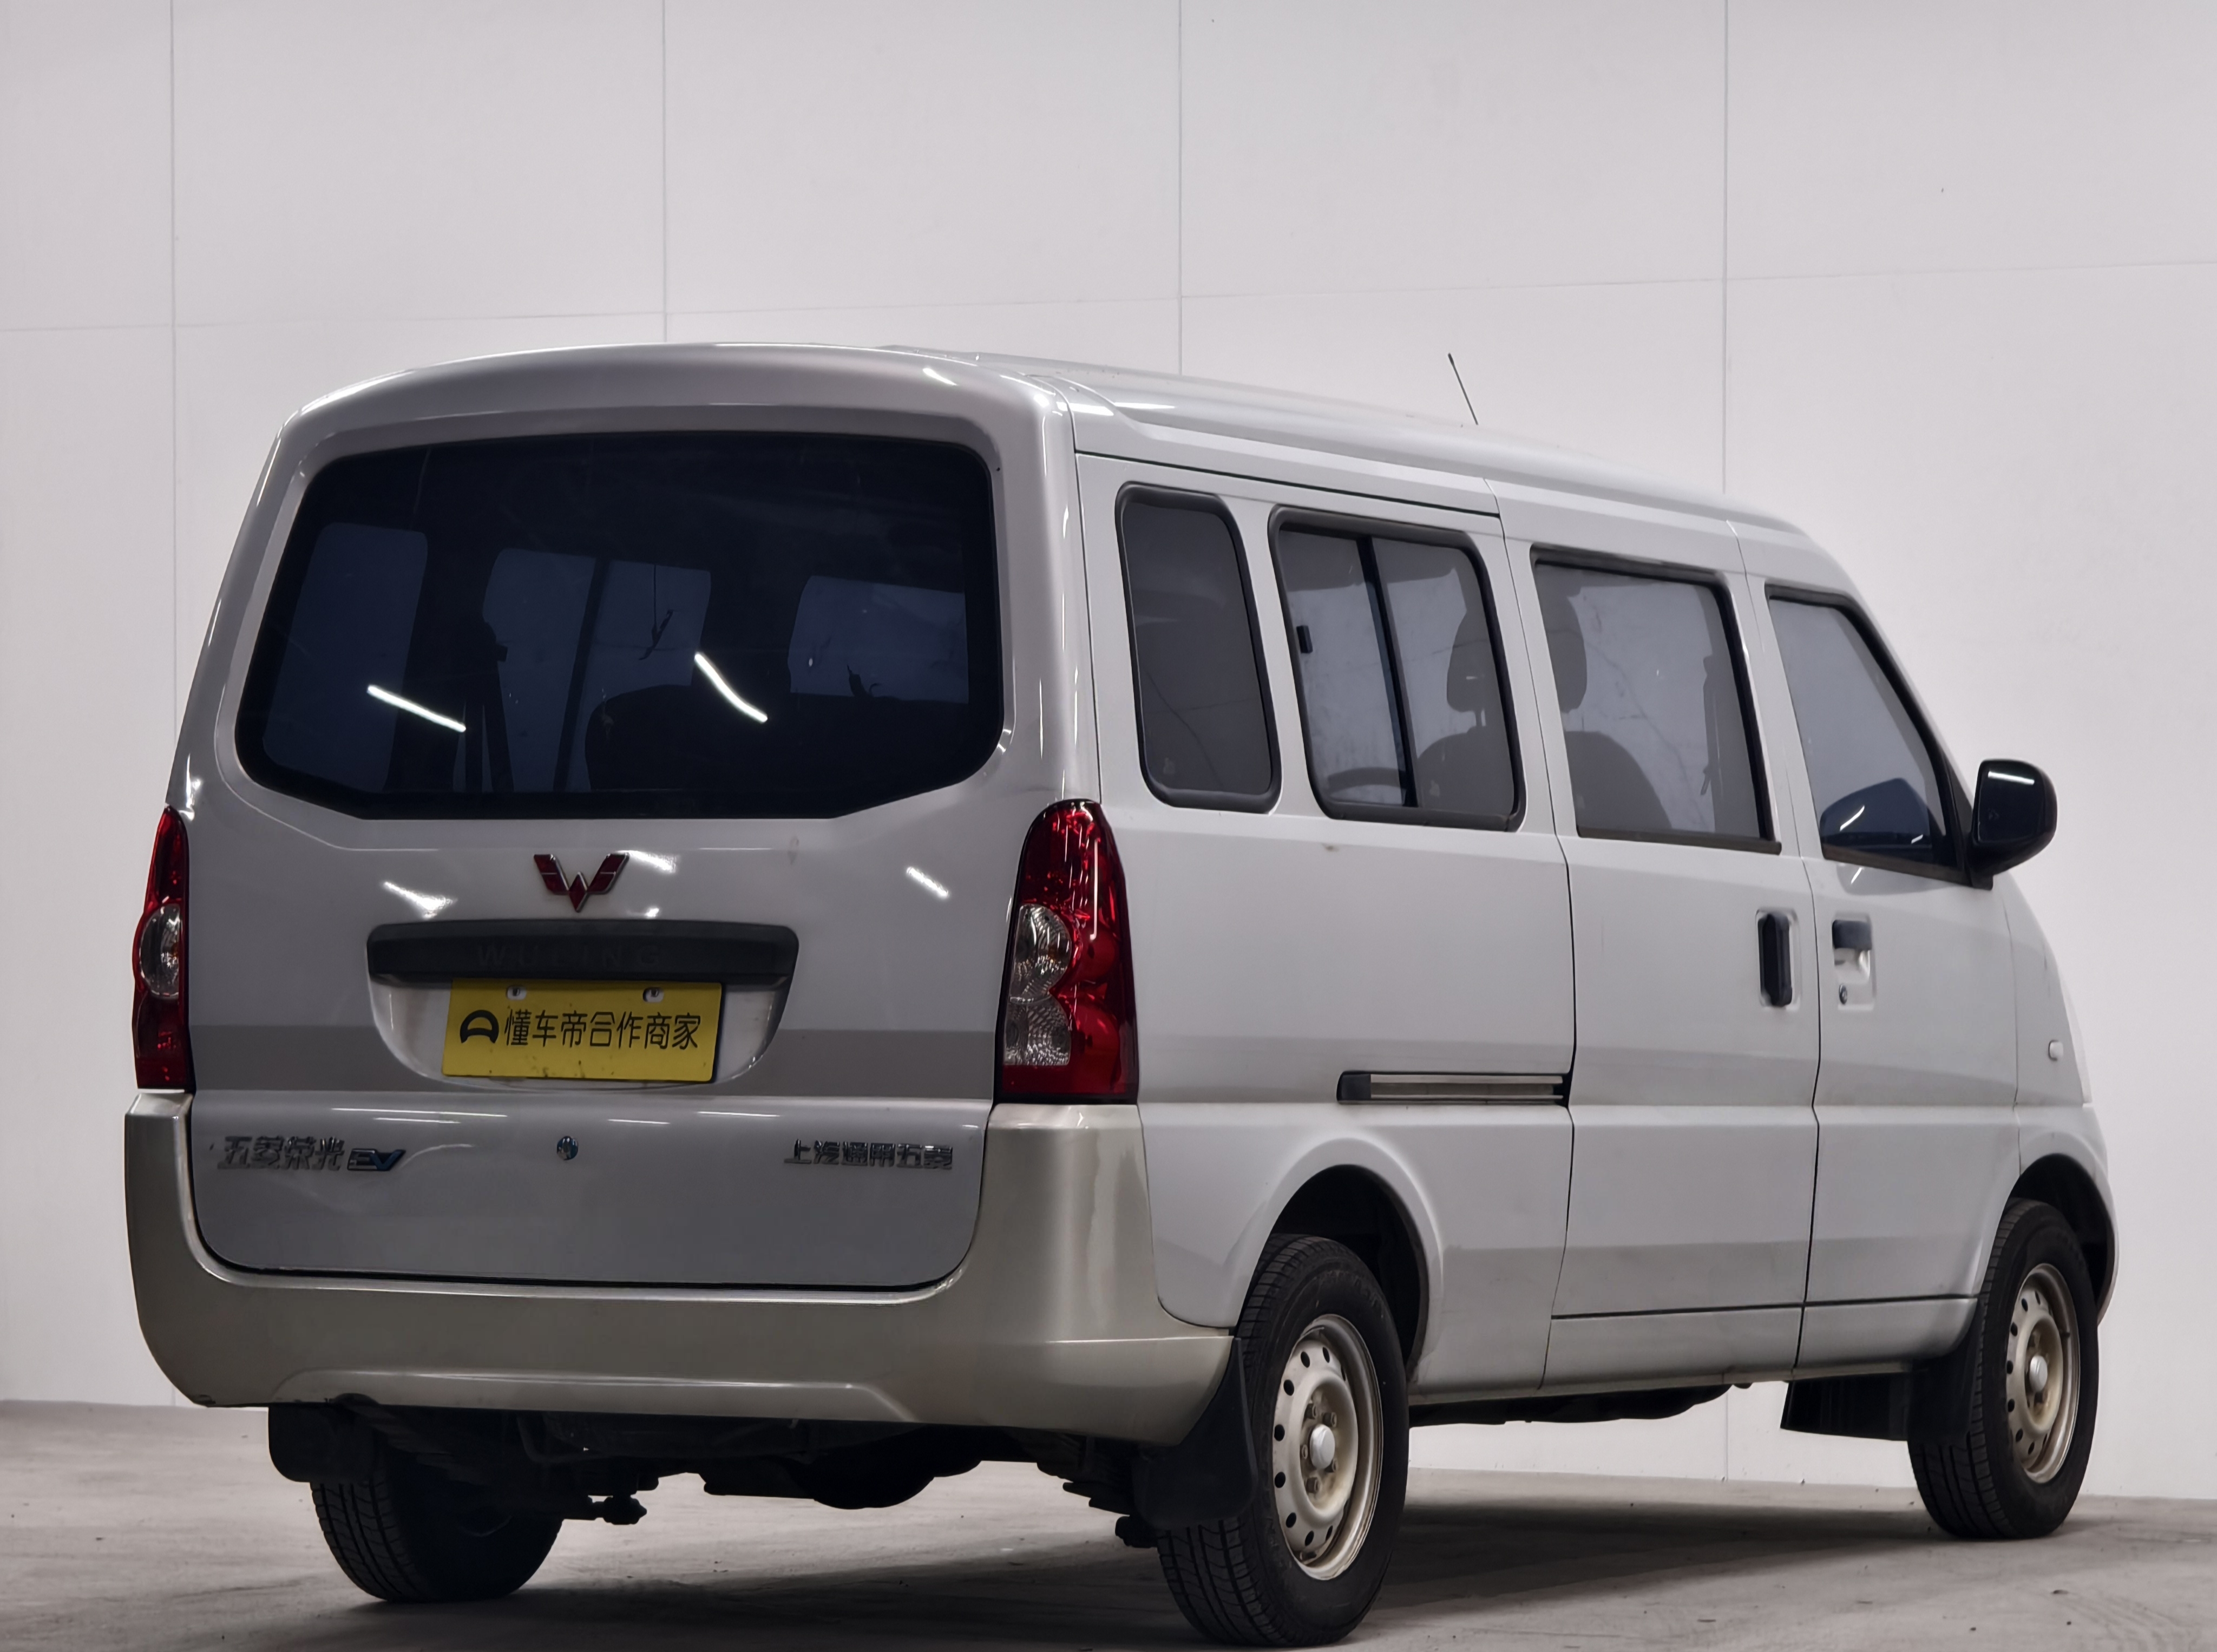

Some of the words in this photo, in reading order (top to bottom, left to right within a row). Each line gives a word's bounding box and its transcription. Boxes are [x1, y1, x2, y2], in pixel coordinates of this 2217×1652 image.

[504, 1008, 701, 1050] 懂车帝合作商家
[217, 1135, 345, 1171] 五菱荣光
[347, 1148, 406, 1171] EV
[784, 1138, 953, 1170] 上汽通用五菱
